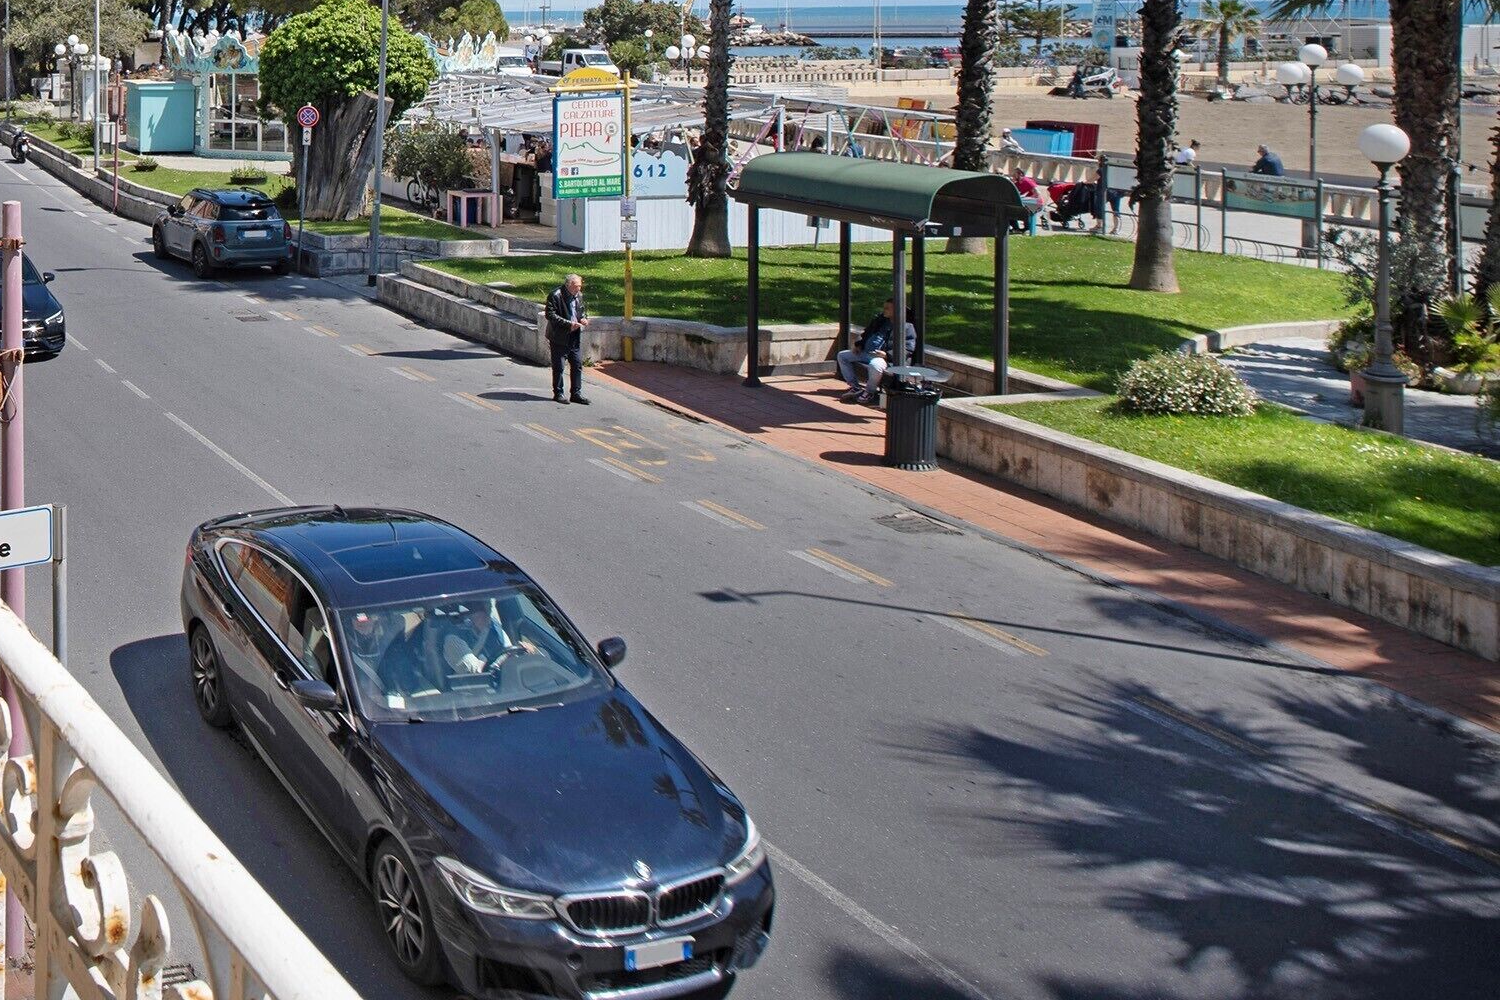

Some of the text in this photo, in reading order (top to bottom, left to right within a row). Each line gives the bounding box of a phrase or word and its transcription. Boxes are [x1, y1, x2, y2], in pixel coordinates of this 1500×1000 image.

[571, 100, 608, 109] CENTRO
[563, 110, 616, 120] CALZATURE
[560, 121, 602, 138] PIERA
[633, 164, 667, 178] 612
[606, 177, 621, 186] MARE
